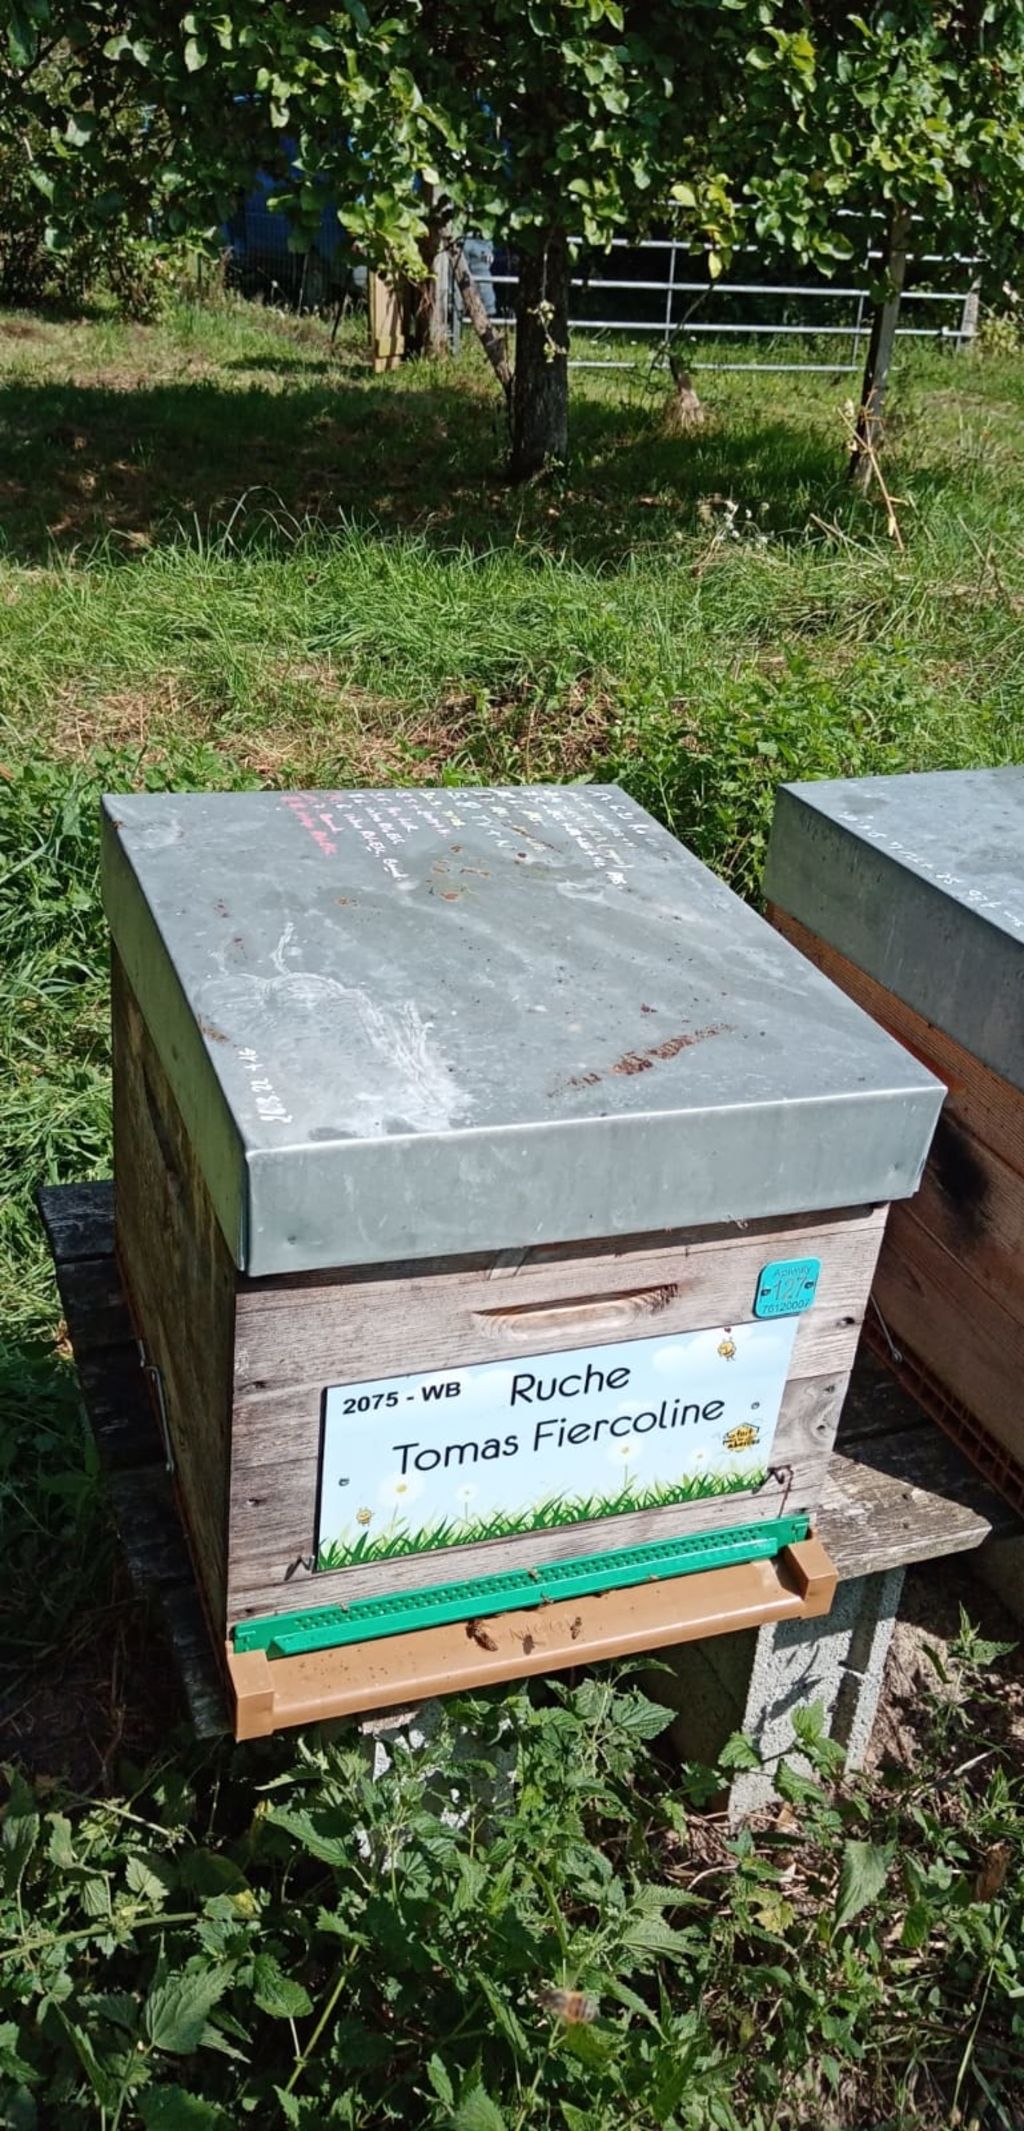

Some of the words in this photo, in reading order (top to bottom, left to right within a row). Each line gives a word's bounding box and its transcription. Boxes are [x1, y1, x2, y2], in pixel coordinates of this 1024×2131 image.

[773, 1276, 807, 1301] 127
[342, 1391, 400, 1416] 2075
[422, 1380, 462, 1403] WB
[509, 1363, 631, 1407] Ruche
[392, 1432, 519, 1475] Tomas
[532, 1398, 727, 1453] Fiercoline
